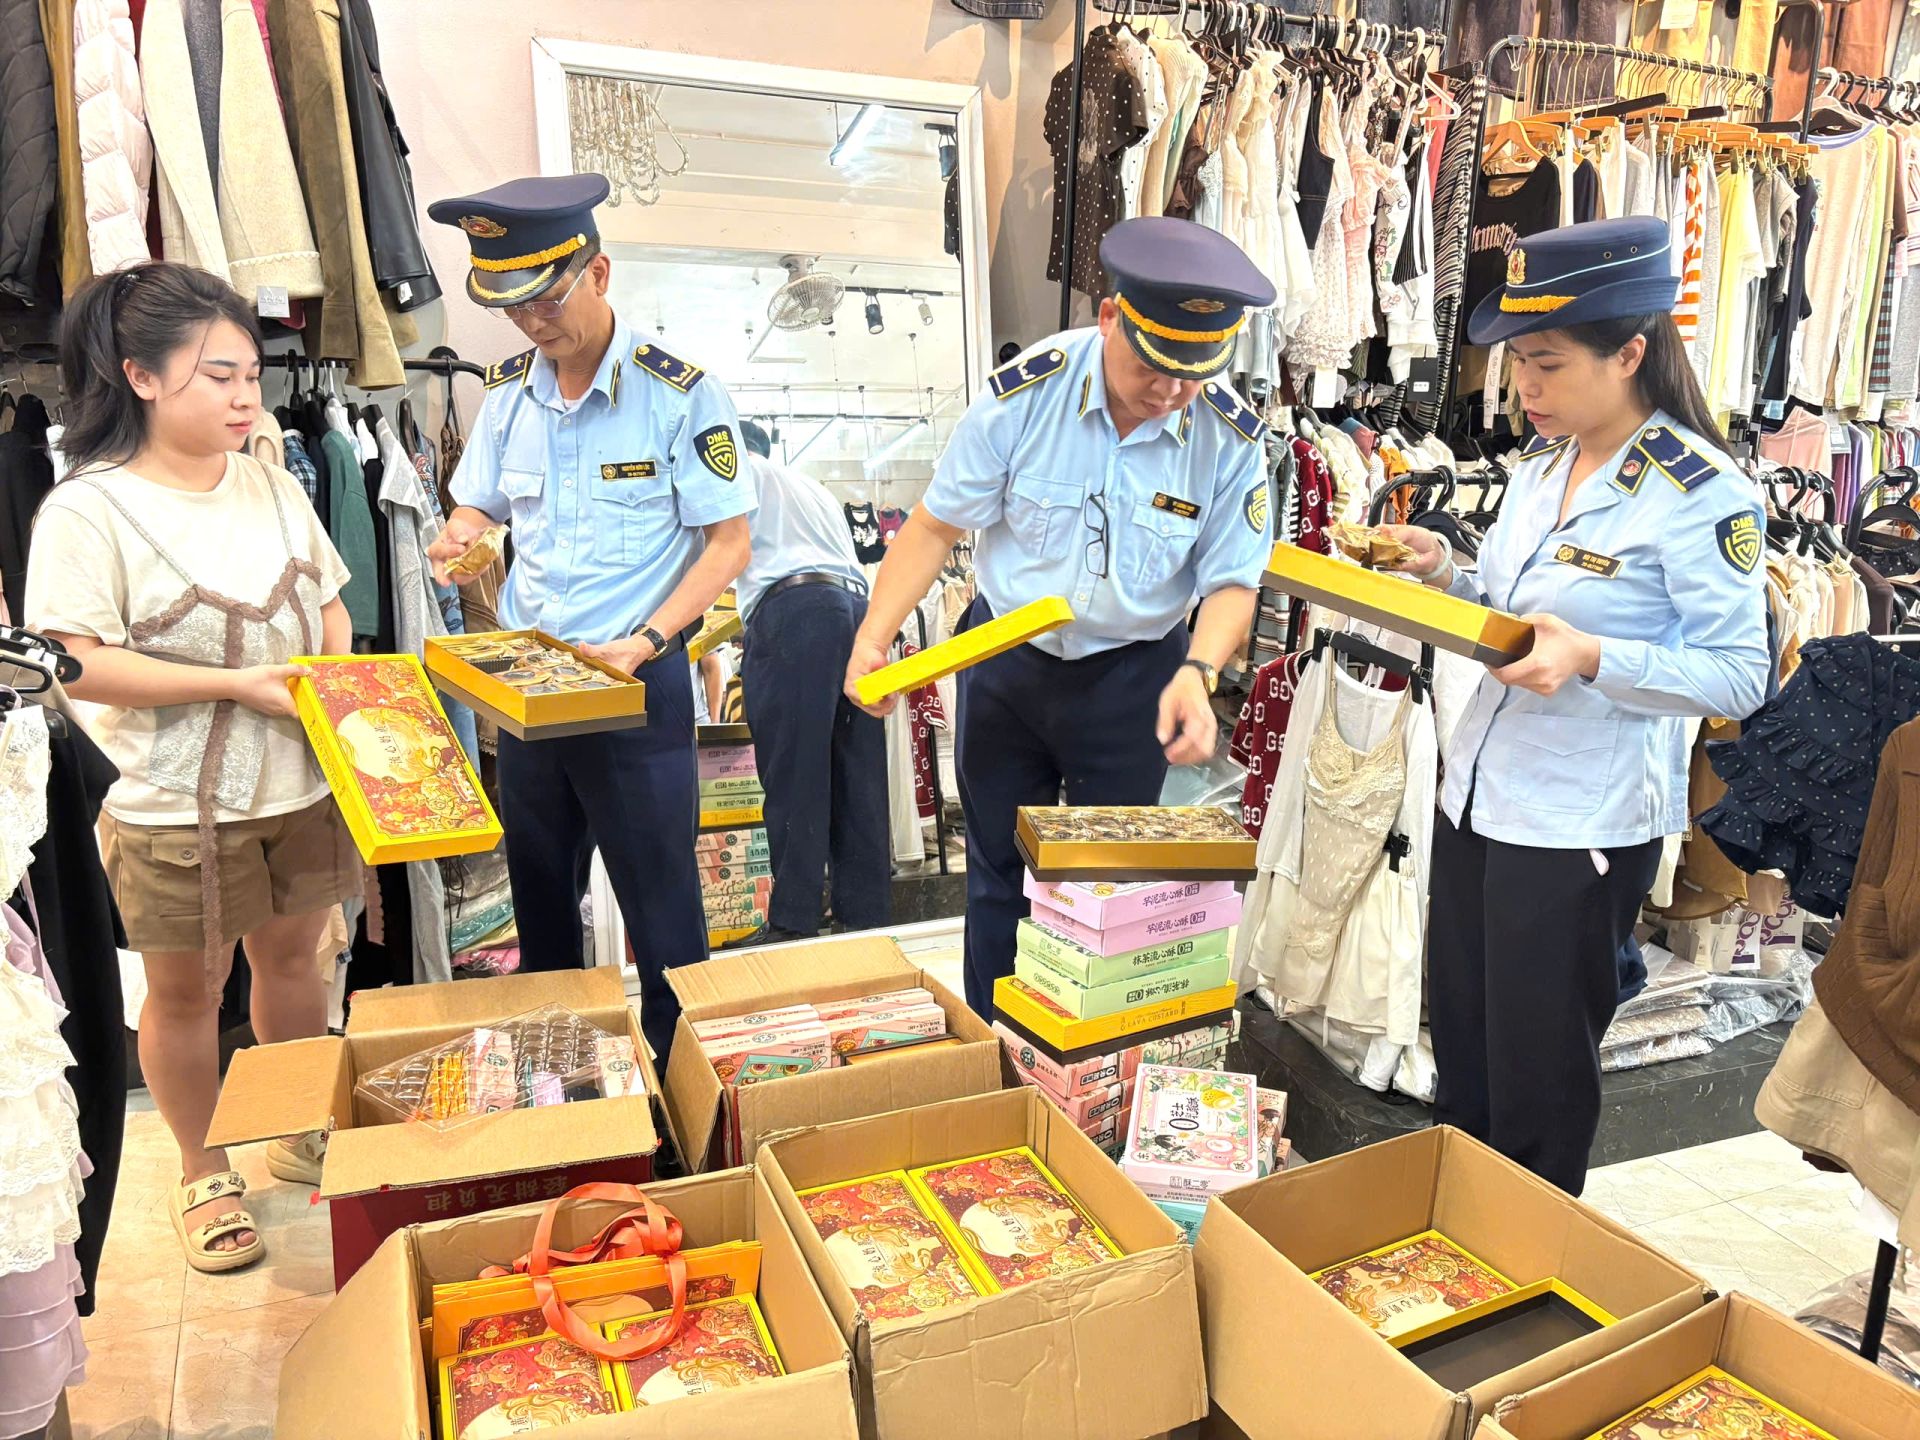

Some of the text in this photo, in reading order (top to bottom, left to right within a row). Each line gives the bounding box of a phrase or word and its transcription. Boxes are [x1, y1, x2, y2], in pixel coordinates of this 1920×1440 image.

[706, 431, 729, 445] DMS
[1731, 516, 1755, 531] DMS
[1132, 948, 1175, 966] 抹茶流心酥
[1148, 1009, 1179, 1023] CUSTARD
[424, 1175, 568, 1212] 轻甜无负担
